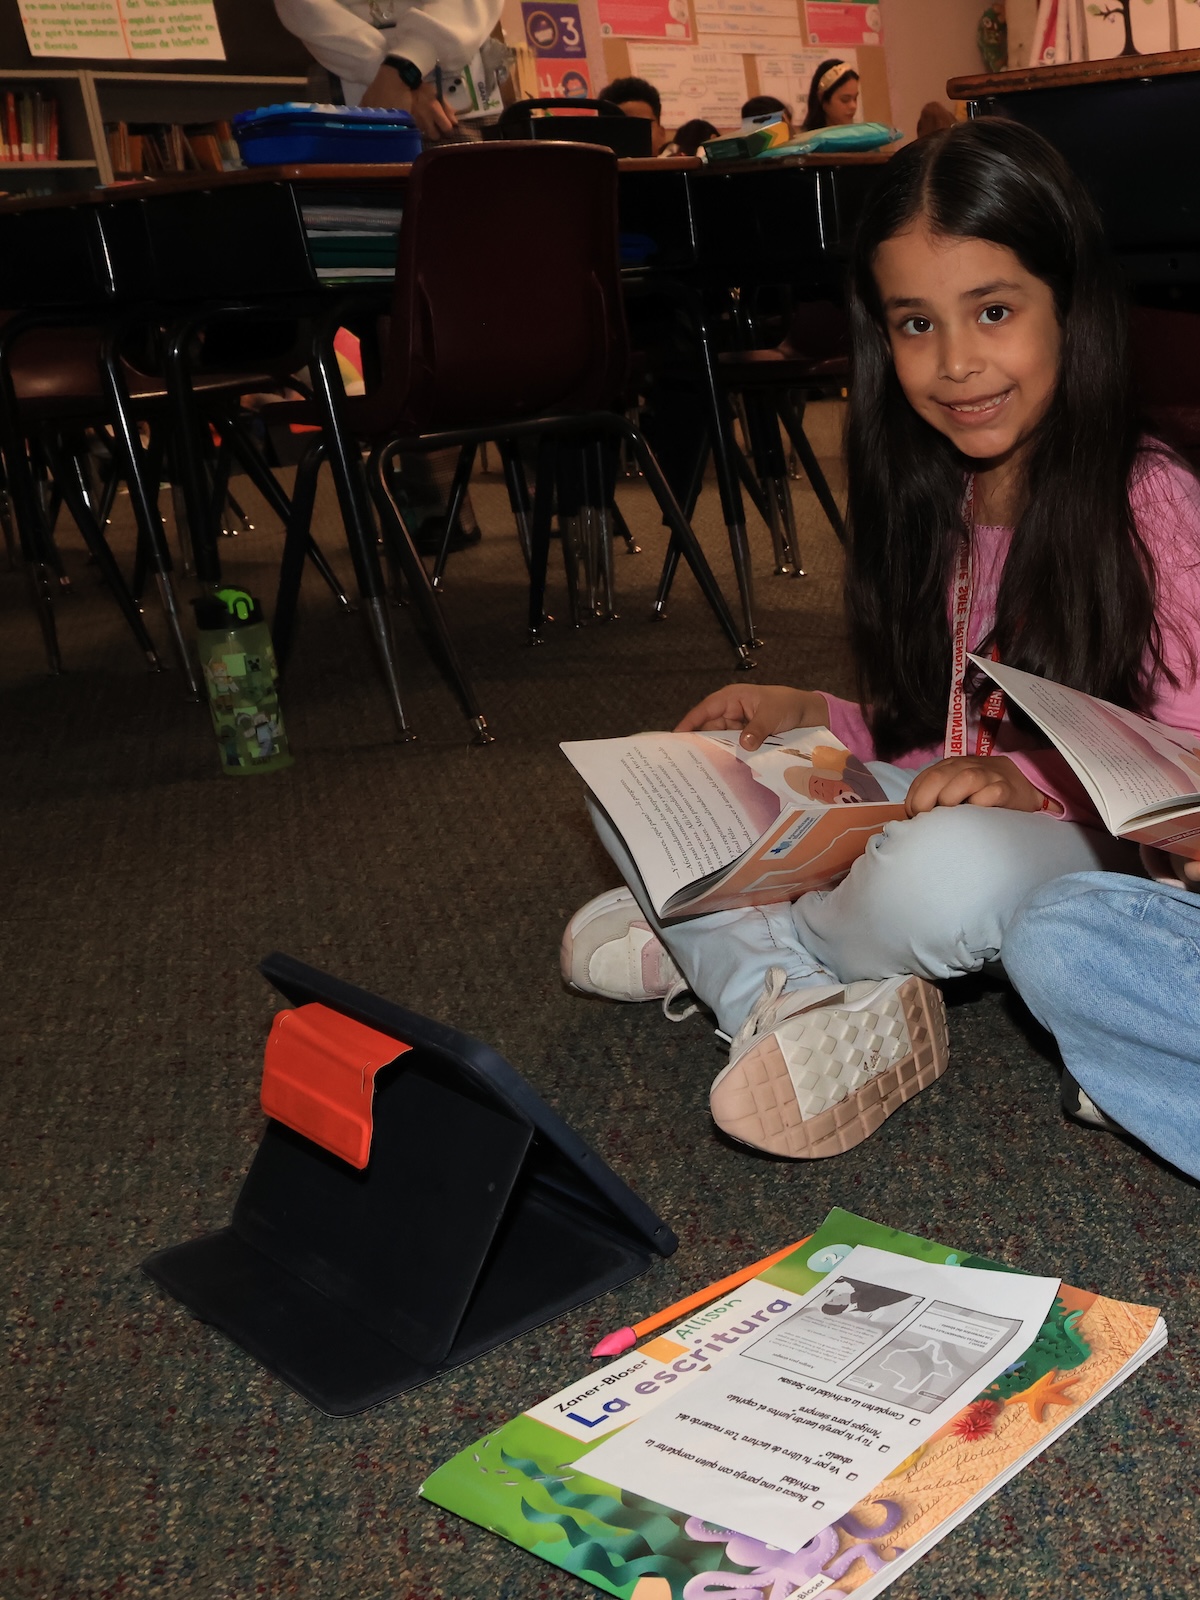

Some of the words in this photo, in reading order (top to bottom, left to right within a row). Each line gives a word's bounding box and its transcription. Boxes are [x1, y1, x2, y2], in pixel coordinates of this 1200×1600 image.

[560, 17, 579, 46] 3
[653, 773, 667, 788] doctor
[664, 803, 674, 815] ellos
[682, 797, 698, 815] pronto
[695, 815, 704, 827] Muy
[730, 810, 746, 830] conocer
[673, 815, 690, 841] tormenta,
[710, 816, 729, 845] respiramos
[661, 839, 676, 866] entonces,
[709, 842, 721, 860] estaba
[726, 846, 734, 854] yo
[704, 853, 713, 865] más
[820, 1249, 844, 1268] 2
[675, 1299, 742, 1340] Allison
[566, 1398, 631, 1428] La
[626, 1295, 792, 1399] escritura
[553, 1360, 647, 1413] Zaner-Bloser
[777, 1377, 806, 1389] Seesaw
[805, 1385, 817, 1395] en
[815, 1389, 852, 1402] actividad
[851, 1399, 861, 1407] la
[675, 1413, 691, 1421] del
[767, 1408, 796, 1421] juntos
[861, 1402, 905, 1420] Completen
[689, 1417, 725, 1433] recuerdo
[792, 1413, 819, 1429] leerán
[830, 1416, 854, 1426] para
[992, 1404, 1029, 1439] pulpo
[818, 1424, 848, 1437] pareja
[844, 1429, 854, 1441] tu
[645, 1439, 656, 1447] la
[741, 1435, 772, 1450] lectura
[771, 1445, 782, 1453] de
[861, 1438, 873, 1447] Tu
[654, 1443, 696, 1460] completar
[781, 1449, 803, 1461] libro
[694, 1457, 718, 1469] quien
[802, 1456, 812, 1464] tu
[812, 1460, 832, 1469] por
[717, 1465, 734, 1474] con
[829, 1466, 840, 1475] Ve
[733, 1471, 764, 1486] pareja
[760, 1480, 776, 1490] una
[779, 1475, 820, 1492] actividad
[861, 1487, 903, 1505] gua
[909, 1470, 981, 1493] salada
[782, 1489, 808, 1503] Busca
[878, 1497, 939, 1550] animales
